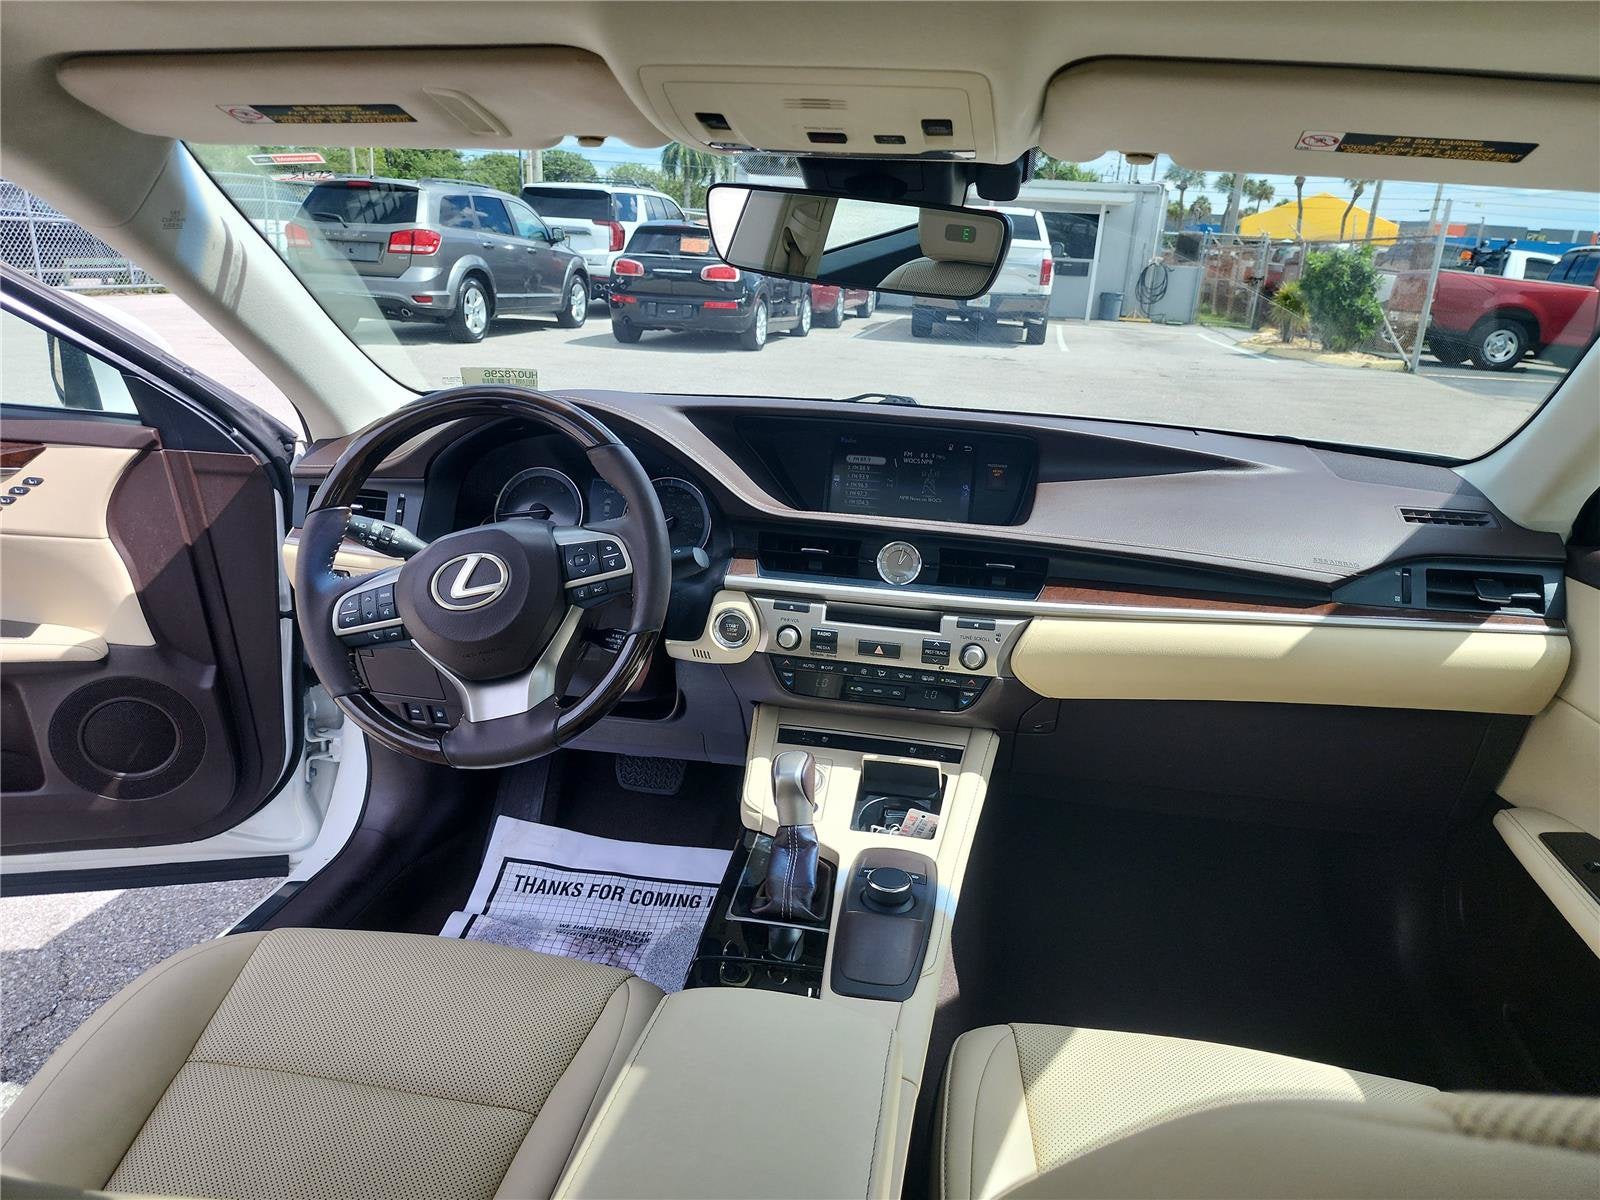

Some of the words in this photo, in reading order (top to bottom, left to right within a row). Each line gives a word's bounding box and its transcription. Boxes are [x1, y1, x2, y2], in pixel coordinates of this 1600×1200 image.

[962, 228, 970, 240] E
[514, 874, 584, 898] THANKS
[587, 883, 625, 902] FOR
[629, 889, 702, 909] COMING
[579, 931, 597, 940] THIS
[598, 936, 624, 947] PAPER
